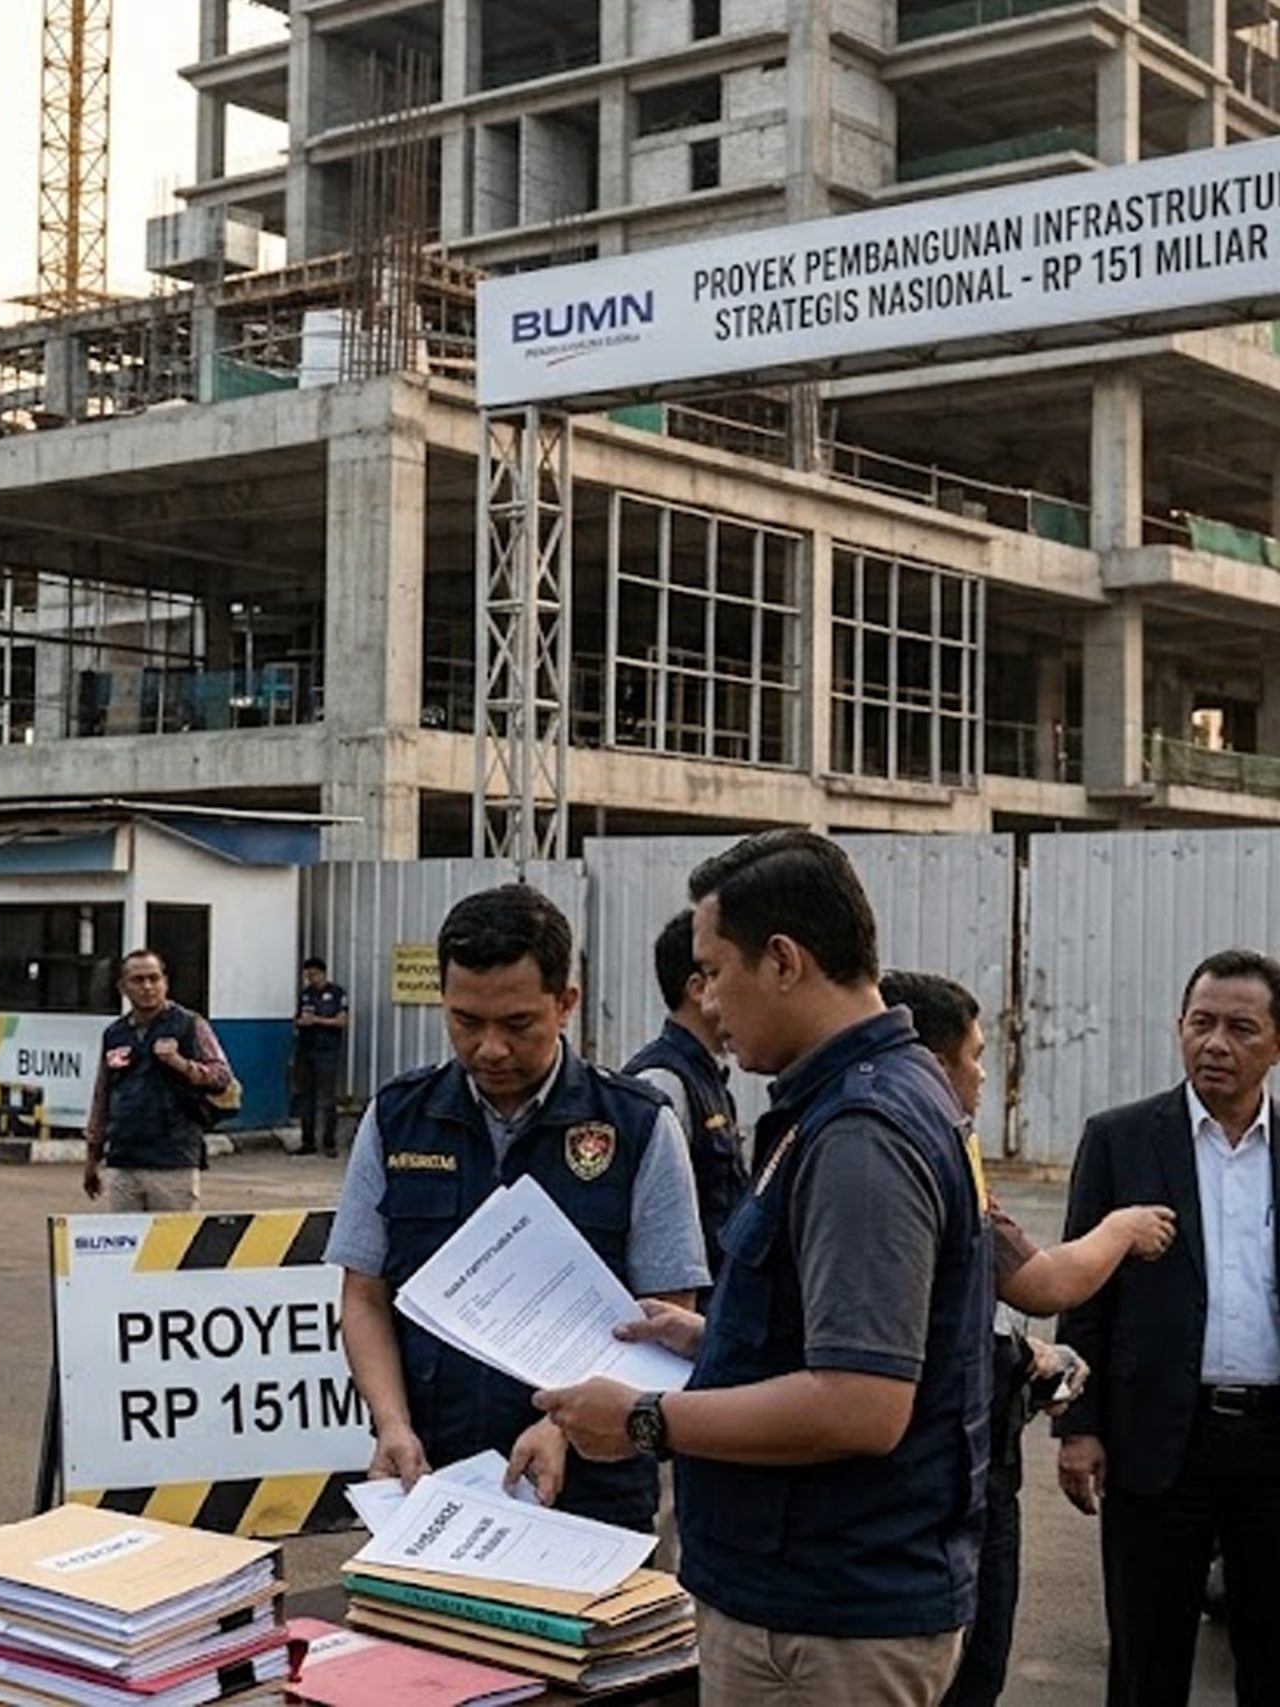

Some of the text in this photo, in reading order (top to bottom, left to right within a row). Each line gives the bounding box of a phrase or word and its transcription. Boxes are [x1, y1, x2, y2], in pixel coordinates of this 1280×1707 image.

[694, 172, 1280, 302] PROYEK PEMBANGUNAN INFRASTRUKTU
[715, 288, 859, 341] STRATEGIS
[869, 265, 1013, 319] NASIONAL
[1043, 253, 1082, 293] RP
[1091, 243, 1143, 285] 151
[1156, 224, 1268, 276] MILIAR
[513, 290, 654, 344] BUMN
[17, 1049, 81, 1078] BUMN
[120, 1387, 199, 1441] RP
